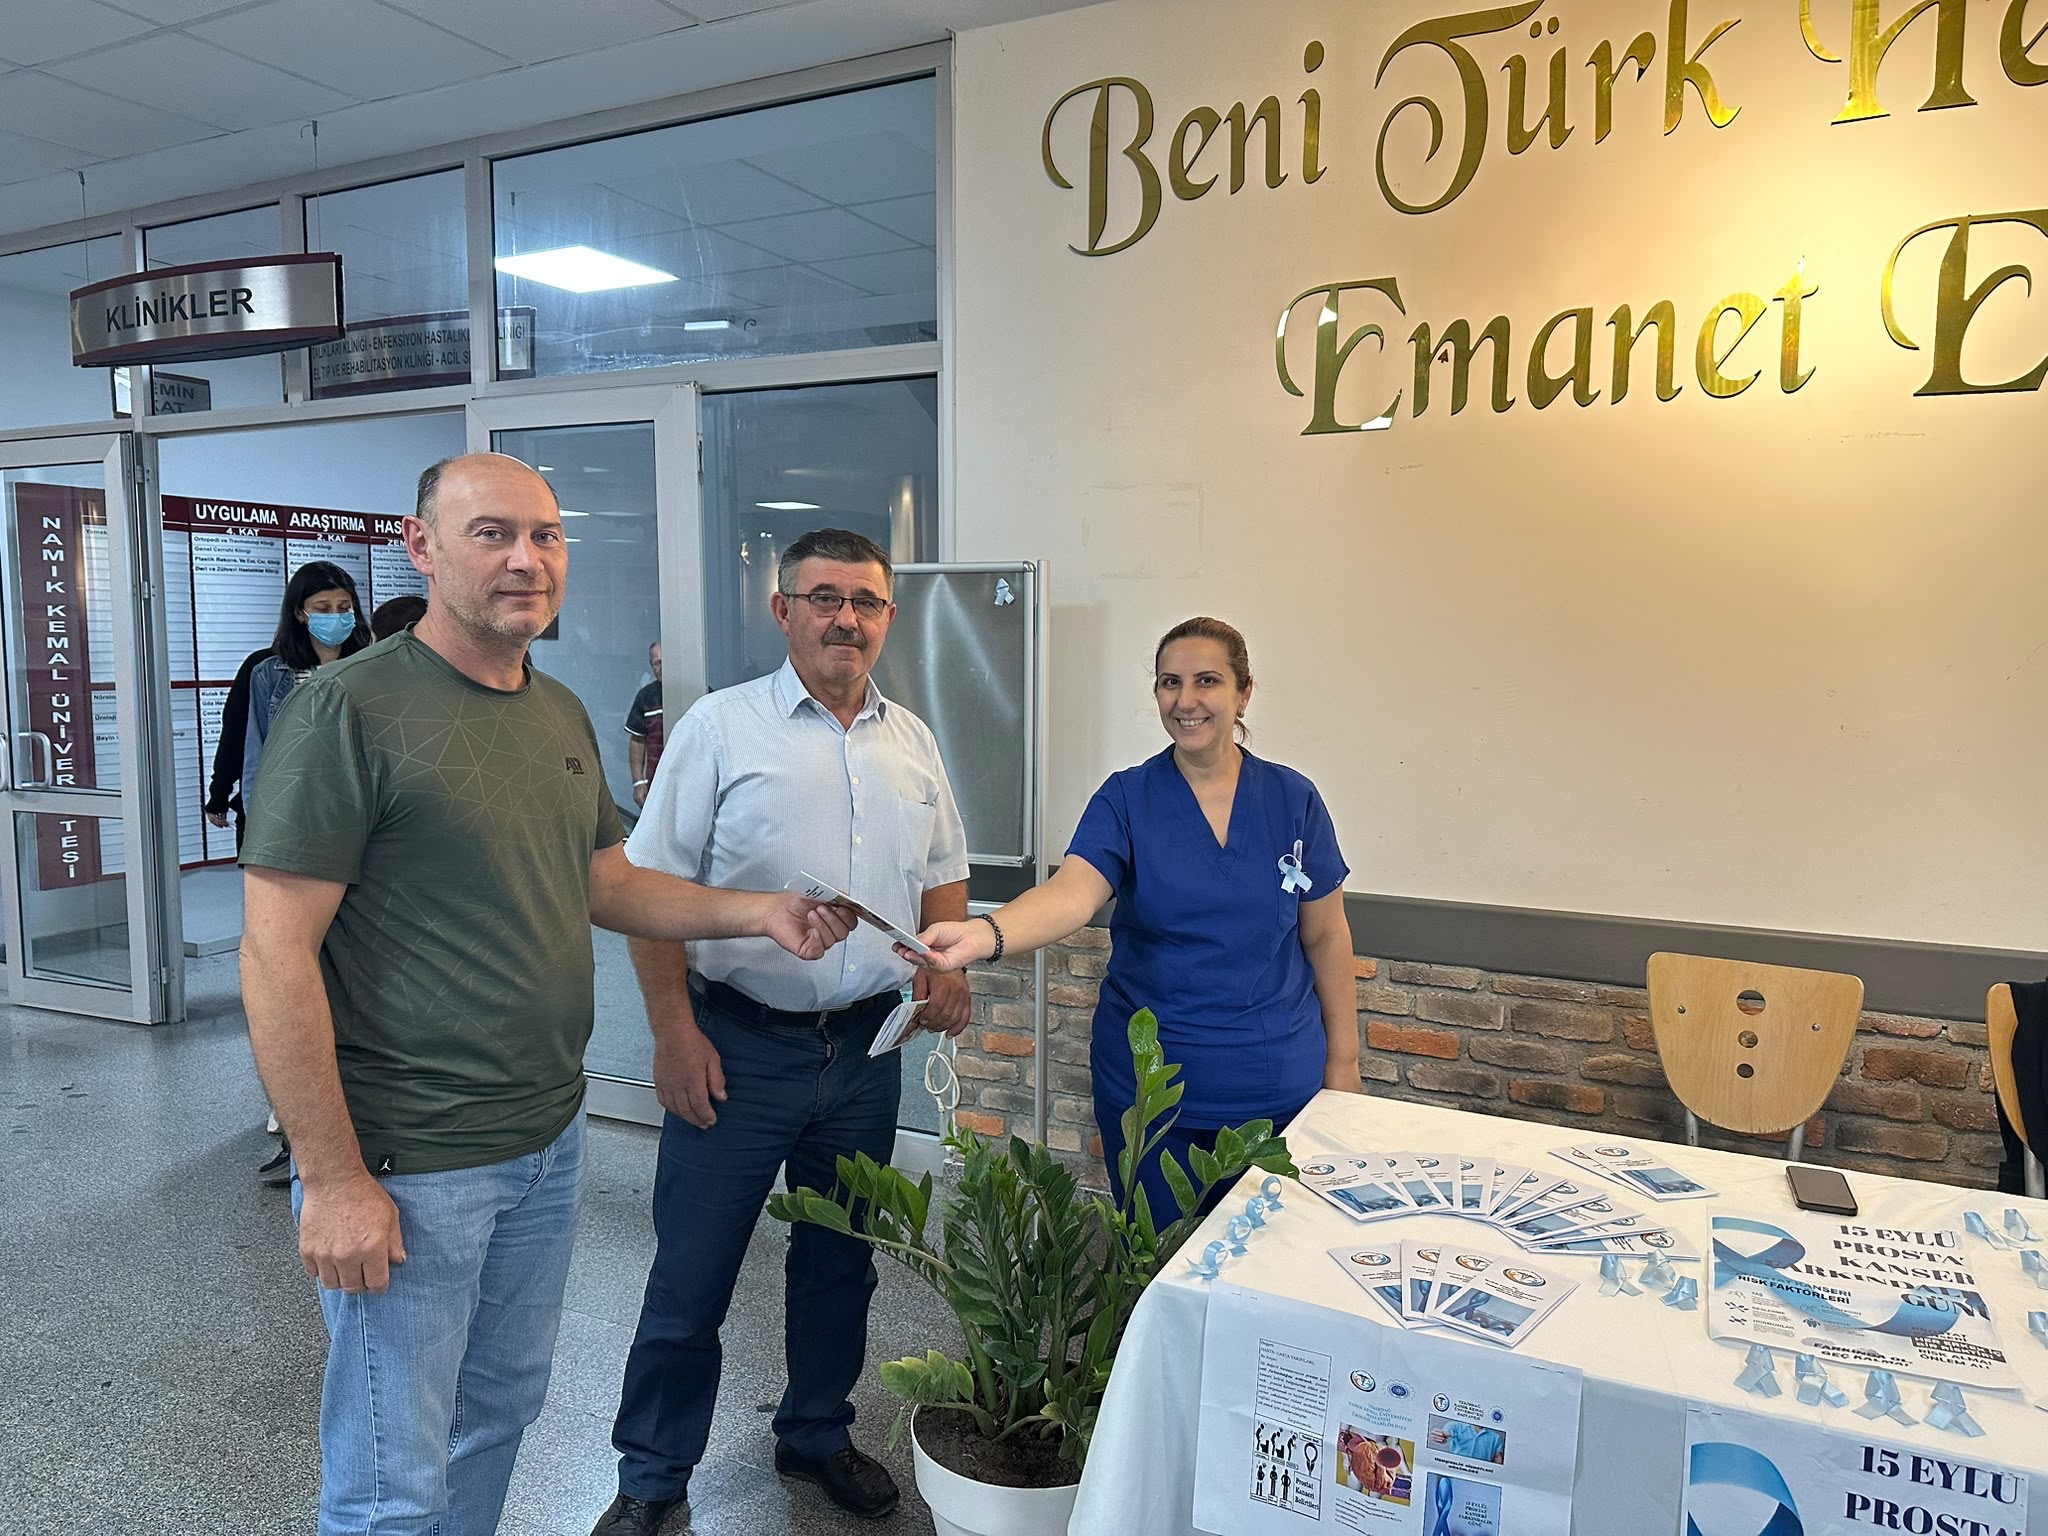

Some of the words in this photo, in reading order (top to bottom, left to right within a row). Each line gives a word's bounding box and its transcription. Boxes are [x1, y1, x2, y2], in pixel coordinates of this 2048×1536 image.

[1041, 39, 1328, 257] Beni
[1374, 0, 1742, 215] Türk
[106, 287, 256, 333] KLİNİKLER
[373, 330, 422, 350] ENFEKSİYON
[1275, 255, 1819, 437] Emanet
[341, 354, 402, 376] REHABİLİTASYON
[404, 349, 434, 369] KLİNİĞİ
[440, 348, 461, 366] ACİL
[195, 503, 279, 526] UYGULAMA
[289, 512, 366, 533] ARAŞTIRMA
[374, 519, 402, 535] HAS
[225, 527, 236, 535] 4.
[239, 528, 260, 537] KAT
[327, 535, 347, 543] KAT
[42, 516, 66, 594] NAMIK
[47, 604, 69, 680] KEMAL
[1838, 1225, 1869, 1237] 15
[1875, 1227, 1958, 1249] EYLÜ
[1832, 1240, 1965, 1267] PROSTA
[1769, 1280, 1851, 1305] FAKTÖRLERİ
[1858, 1444, 1901, 1478] 15
